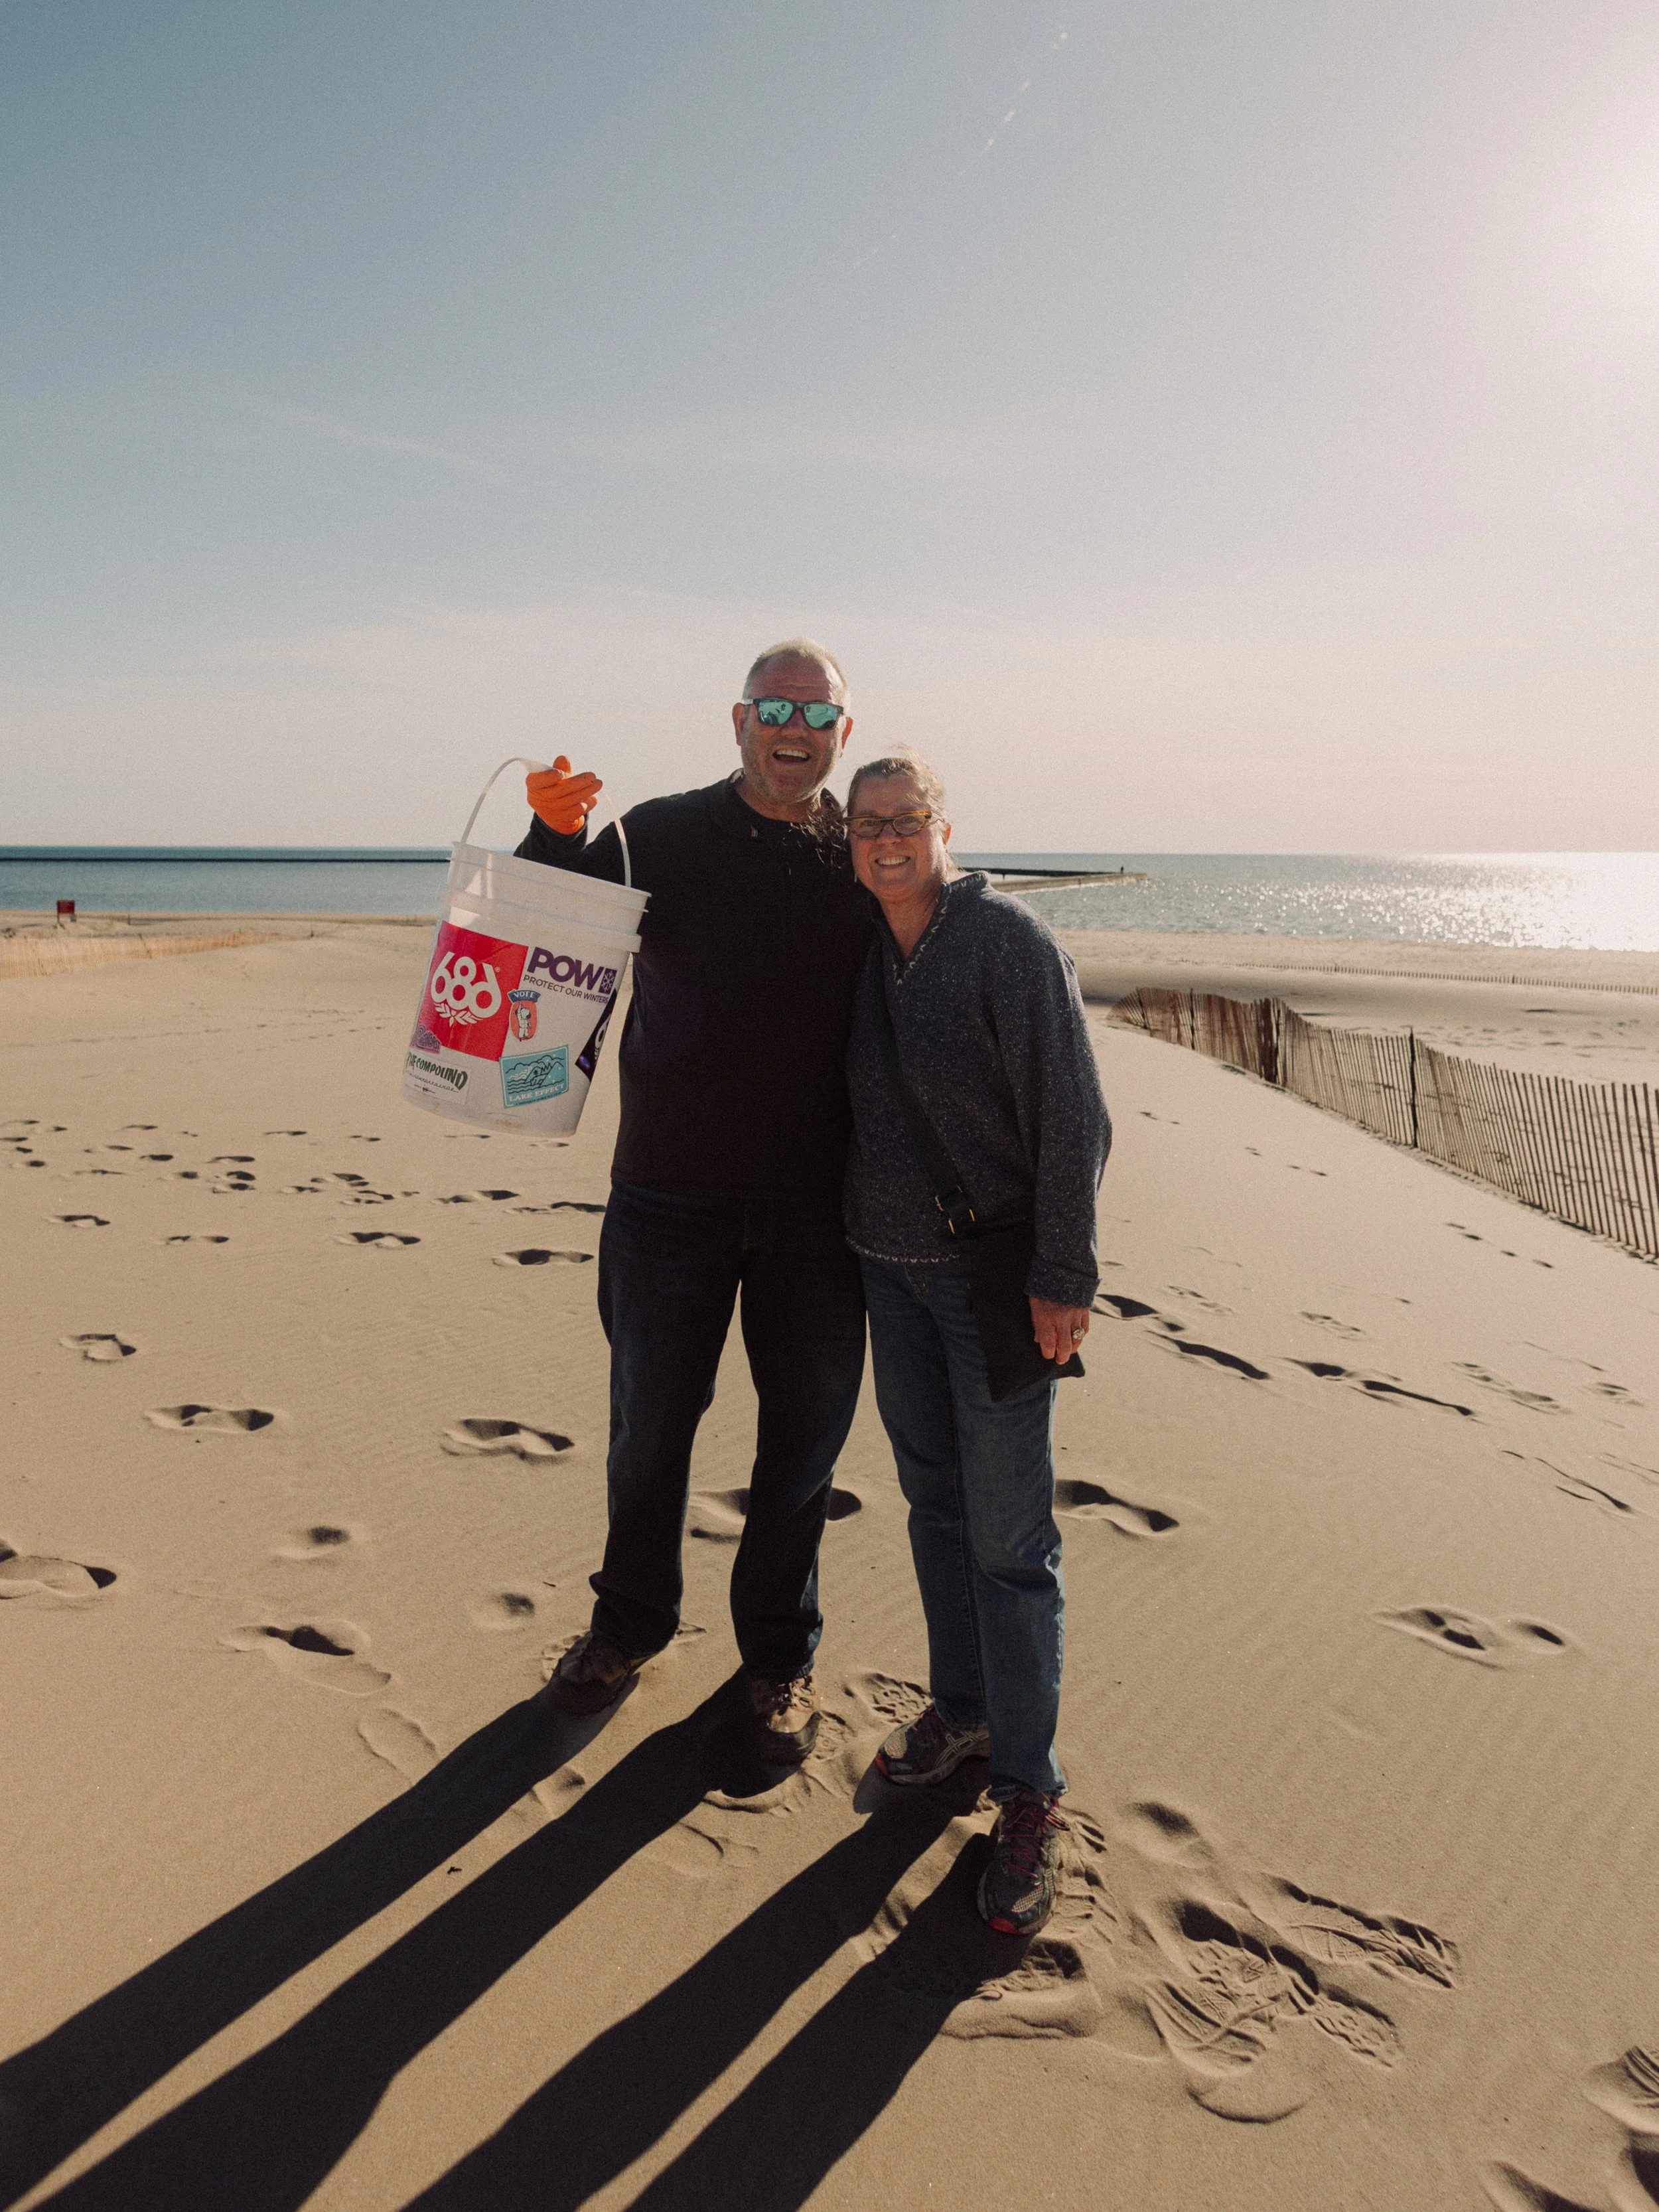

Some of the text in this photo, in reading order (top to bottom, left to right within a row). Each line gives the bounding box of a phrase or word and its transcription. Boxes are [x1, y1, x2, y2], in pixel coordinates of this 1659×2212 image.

[527, 946, 605, 991] POW
[523, 975, 609, 1003] PROTECT OUR WINTERS
[416, 1058, 468, 1090] COMPOUND
[509, 1092, 532, 1102] LAKE
[535, 1083, 563, 1096] EFFECT
